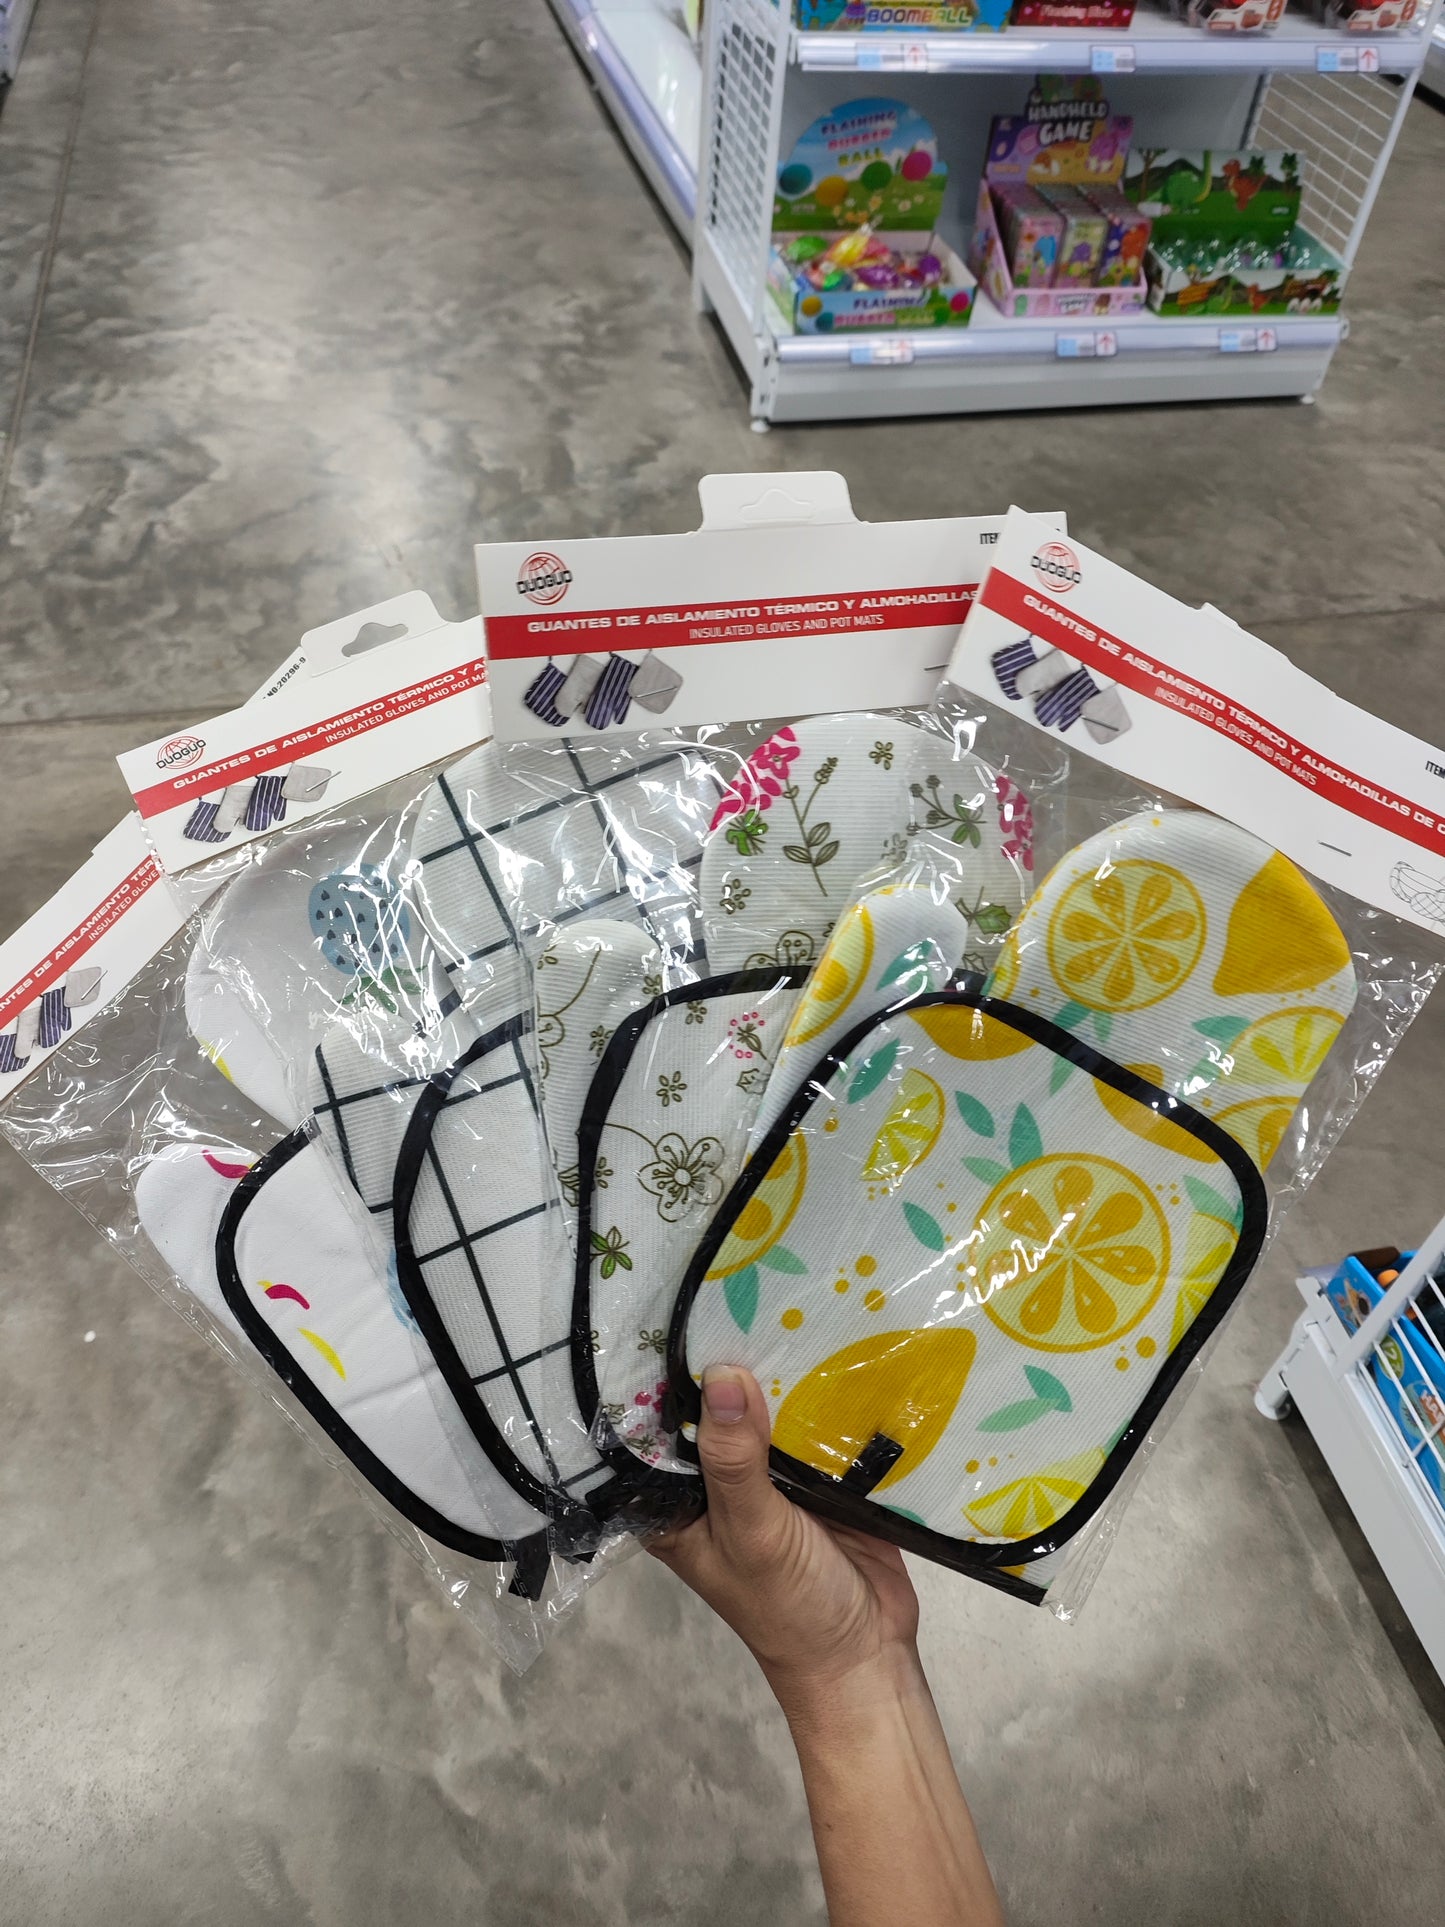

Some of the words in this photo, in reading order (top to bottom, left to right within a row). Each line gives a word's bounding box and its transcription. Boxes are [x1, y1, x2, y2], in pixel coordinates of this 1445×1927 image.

[866, 7, 971, 24] BOOMBALL
[1028, 101, 1108, 122] HANDHELD
[1039, 120, 1093, 145] GAME
[516, 569, 573, 595] DUOGUO
[1031, 555, 1082, 585] DUOGUO
[527, 616, 612, 633] GUANTES
[616, 615, 641, 627] DE
[645, 606, 761, 625] AISLAMIENTO
[763, 601, 840, 616] TÉRMICO
[842, 599, 855, 610] Y
[859, 590, 978, 609] ALMOHADILLAS
[689, 624, 755, 639] INSULATED
[757, 621, 802, 634] GLOVES
[803, 617, 828, 630] AND
[830, 616, 852, 628] POT
[853, 614, 884, 626] MATS
[173, 754, 251, 789] GUANTES
[254, 745, 278, 758] DE
[282, 702, 386, 749] AISLAMIENTO
[387, 674, 455, 705] TÉRMICO
[456, 667, 468, 676] Y
[325, 714, 384, 744] INSULATED
[385, 698, 426, 718] GLOVES
[428, 687, 450, 701] AND
[450, 678, 470, 691] POT
[1023, 594, 1097, 642] GUANTES
[1097, 636, 1122, 656] DE
[1121, 652, 1226, 711] AISLAMIENTO
[1228, 705, 1288, 749] TÉRMICO
[1290, 744, 1301, 756] Y
[1301, 754, 1412, 817] ALMOHADILLAS
[1413, 811, 1435, 829] DE
[156, 739, 207, 770] DUOGUO
[1154, 686, 1215, 722] INSULATED
[1215, 716, 1254, 745] GLOVES
[1253, 739, 1275, 758] AND
[1274, 752, 1293, 770] POT
[1291, 764, 1317, 786] MATS
[88, 896, 132, 941] INSULATED
[0, 977, 34, 1011] NTES
[33, 959, 53, 978] DE
[55, 883, 130, 960] AISLAMIENTO
